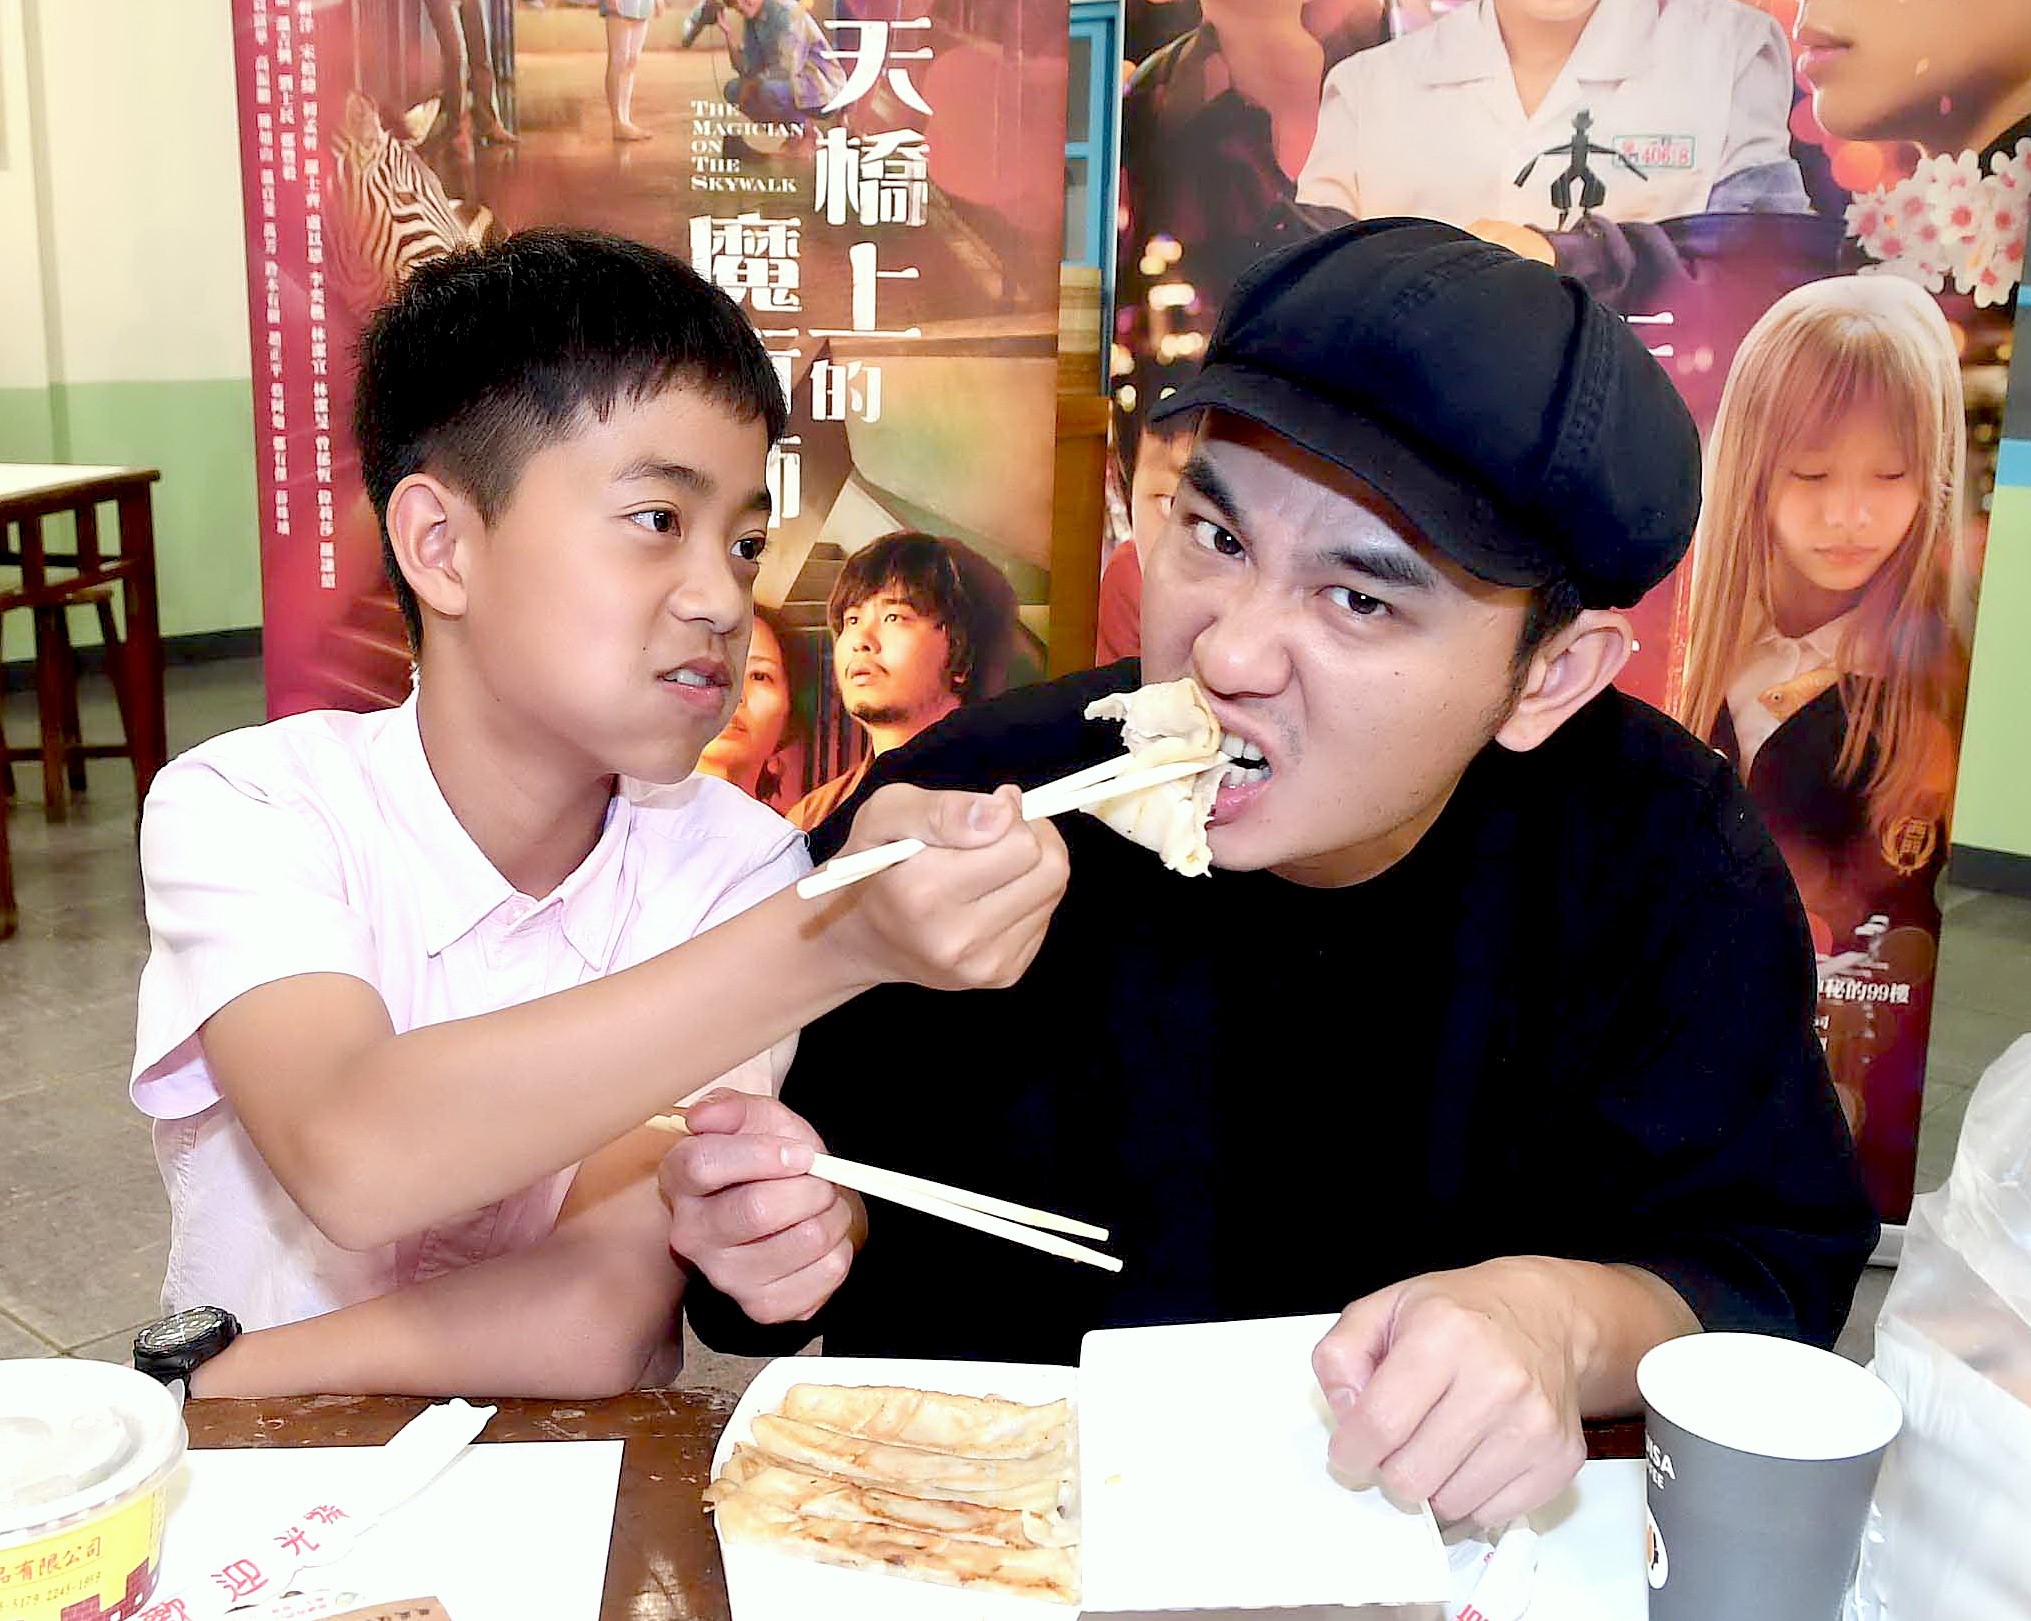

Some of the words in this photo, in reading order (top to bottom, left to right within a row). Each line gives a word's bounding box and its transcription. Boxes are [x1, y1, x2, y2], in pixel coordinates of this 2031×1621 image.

[690, 99, 741, 117] THE
[691, 119, 806, 137] MAGICIAN
[690, 139, 723, 154] ON
[690, 156, 741, 174] THE
[690, 174, 798, 193] SKYWALK
[809, 16, 934, 423] 天橋上的
[1819, 977, 1911, 1004] 秘的99樓
